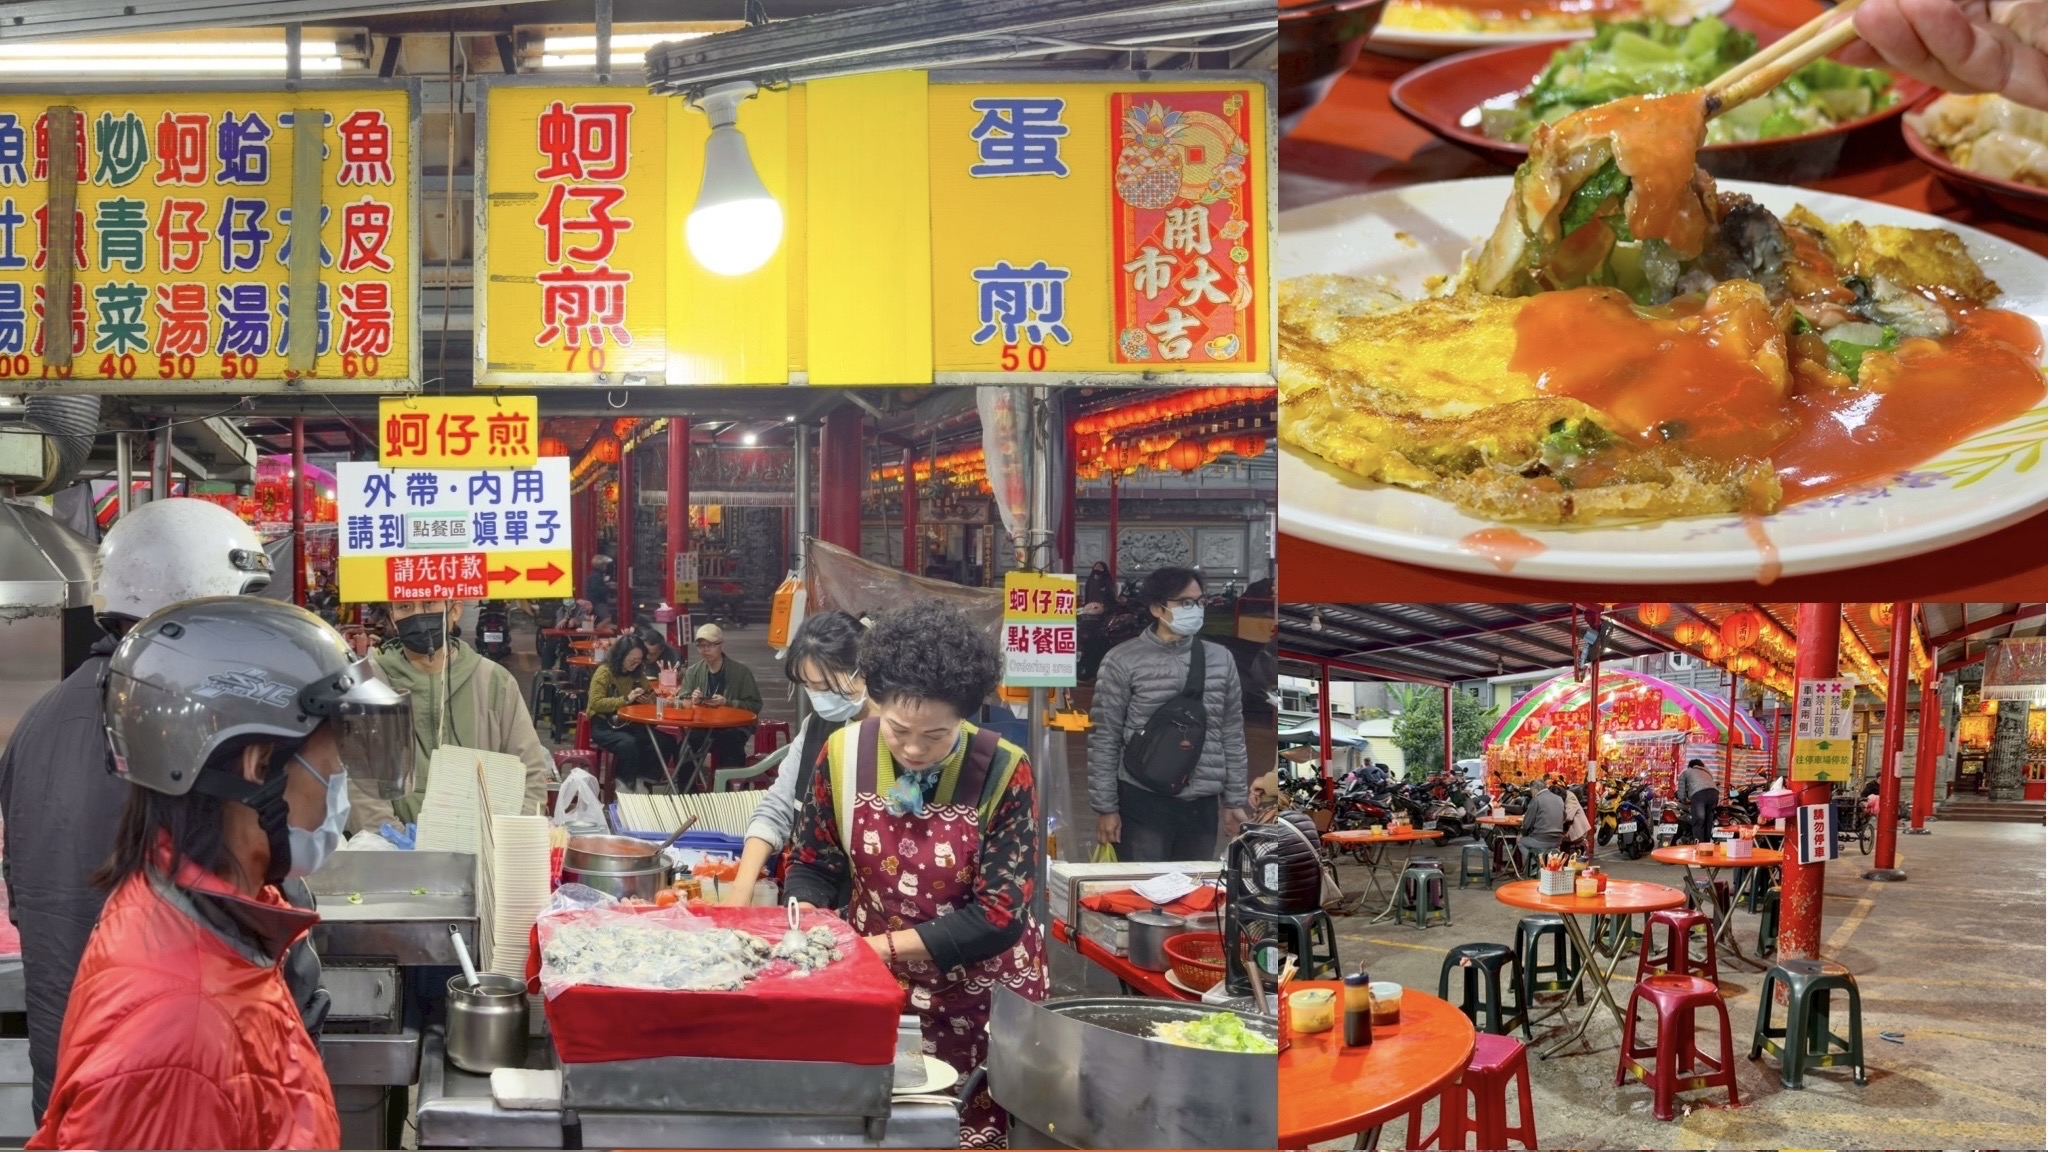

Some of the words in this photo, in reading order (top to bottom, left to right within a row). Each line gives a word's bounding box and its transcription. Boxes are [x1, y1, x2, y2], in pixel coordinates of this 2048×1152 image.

[95, 111, 149, 354] 炒青菜
[155, 111, 210, 355] 蚵仔湯
[217, 111, 271, 355] 蛤仔湯
[339, 110, 393, 355] 魚皮湯
[535, 103, 633, 345] 蚵仔煎
[970, 98, 1072, 344] 蛋煎
[100, 353, 137, 378] 40
[158, 353, 196, 378] 50
[221, 353, 258, 378] 50
[343, 352, 379, 378] 60
[563, 346, 606, 372] 70
[1001, 344, 1048, 371] 50
[385, 412, 530, 457] 蚵仔煎
[347, 513, 405, 550] 請到
[413, 520, 467, 538] 點餐區
[393, 555, 482, 583] 請先付款
[394, 585, 432, 599] Please
[433, 584, 454, 600] Pay
[456, 582, 484, 597] First
[1009, 588, 1075, 615] 蚵仔煎
[1006, 625, 1076, 655] 點餐區
[1009, 659, 1051, 676] Ordering
[1798, 685, 1813, 733] 車道兩側
[1814, 695, 1827, 738] 禁止臨停
[1829, 695, 1842, 737] 禁止停車
[1796, 755, 1849, 765] 往停車場停放
[1813, 808, 1826, 858] 請勿停車
